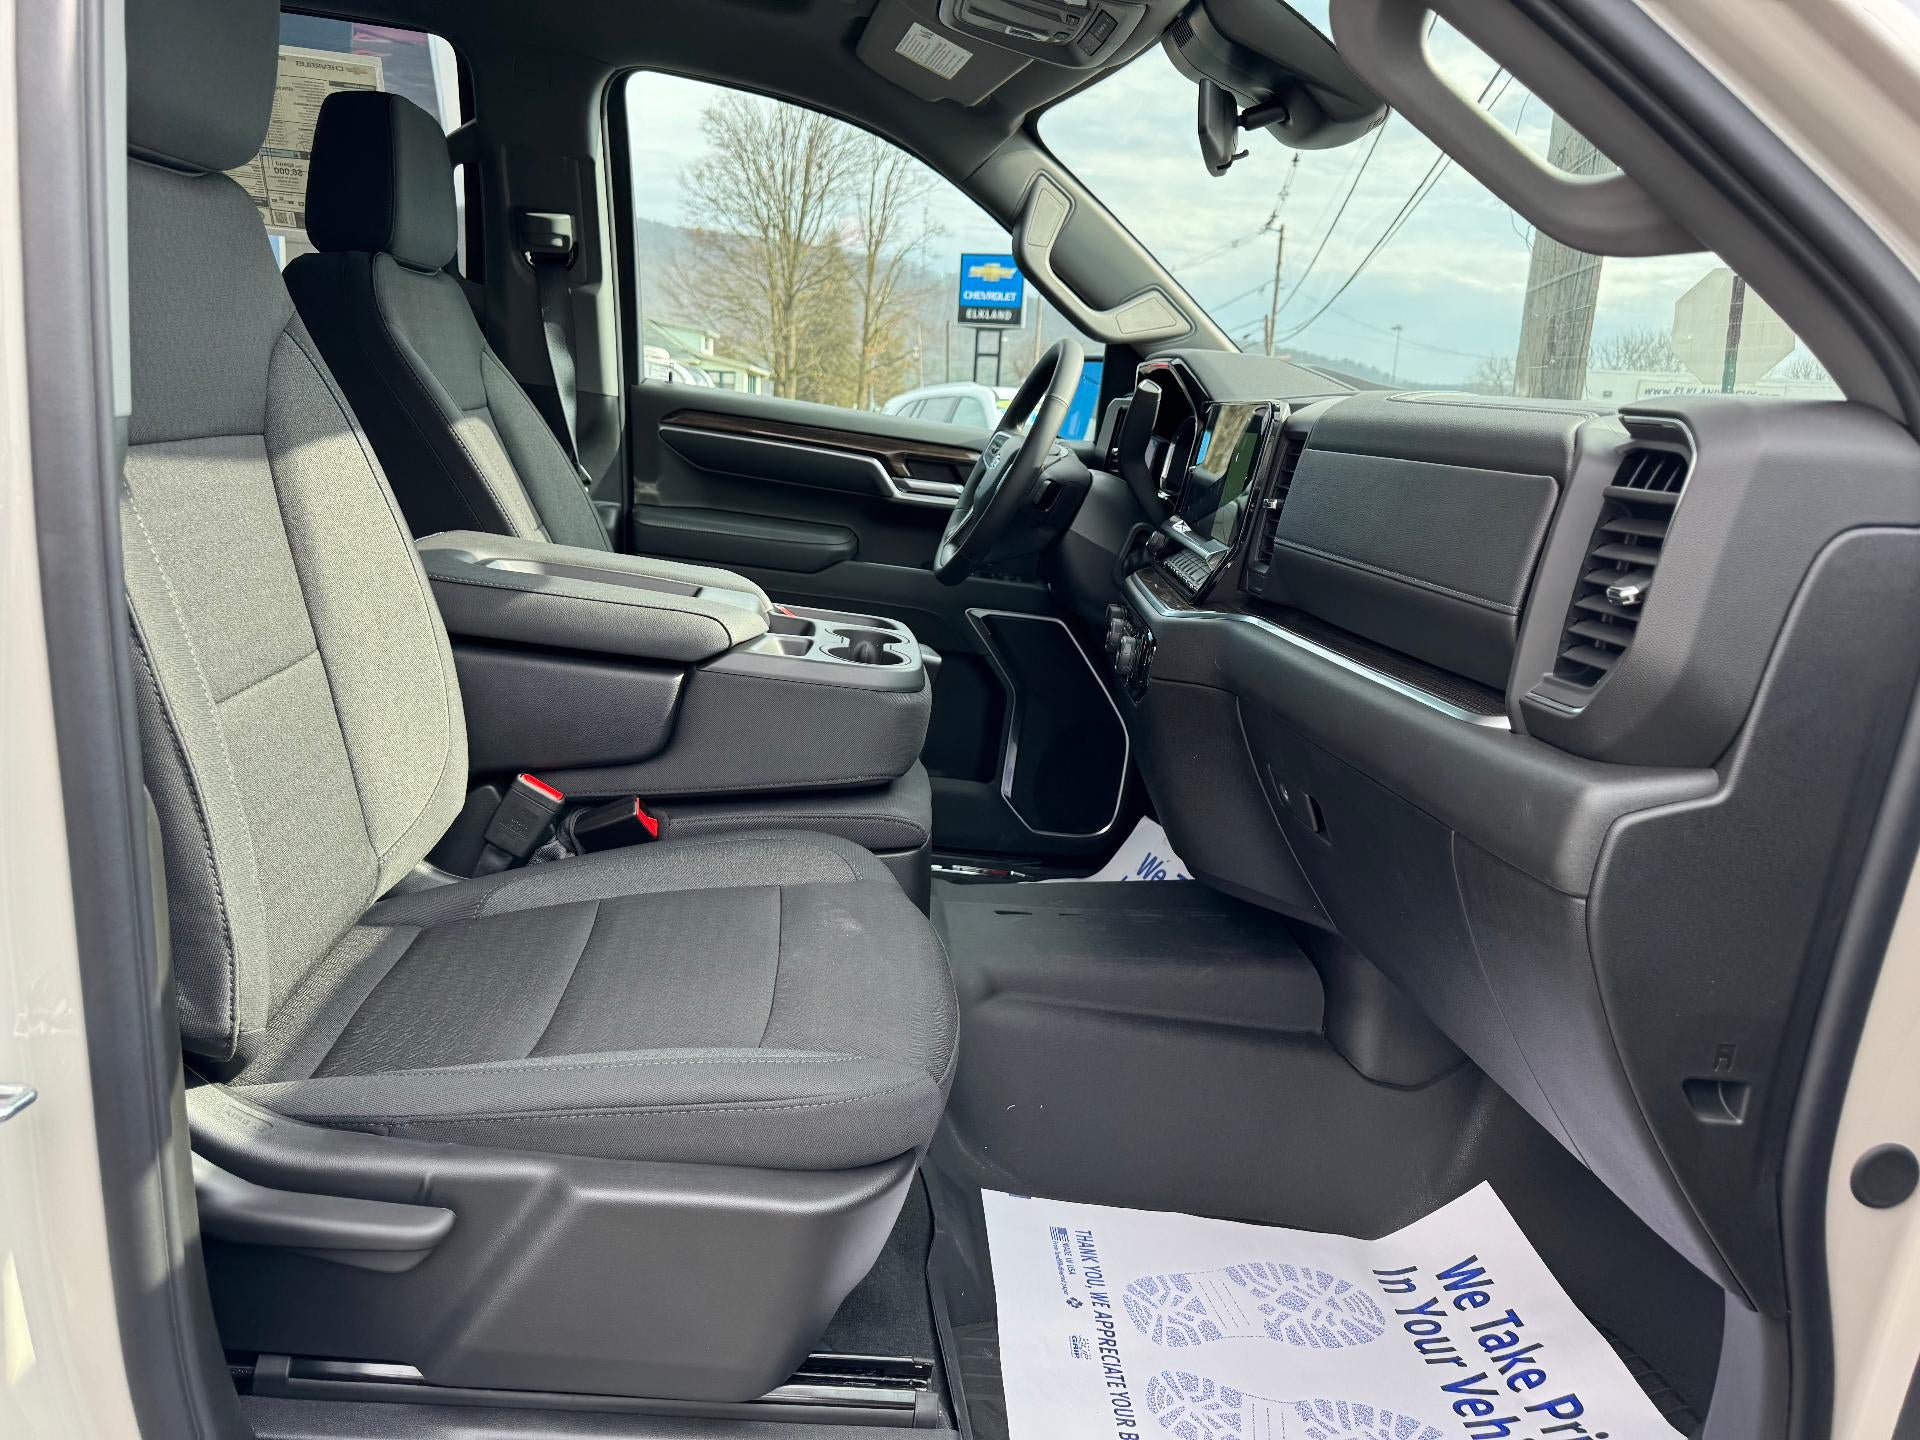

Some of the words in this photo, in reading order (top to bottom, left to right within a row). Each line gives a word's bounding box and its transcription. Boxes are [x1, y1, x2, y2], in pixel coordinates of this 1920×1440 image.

[963, 291, 1016, 301] CHEVROLET
[966, 308, 1012, 320] ELKLAND
[1075, 1230, 1099, 1263] THANK
[1083, 1265, 1106, 1288] YOU,
[1089, 1292, 1111, 1308] WE
[1435, 1254, 1494, 1311] We
[1470, 1308, 1547, 1393] Take
[1094, 1309, 1127, 1388] APPRECIATE
[1372, 1265, 1418, 1294] In
[1395, 1296, 1468, 1368] Your
[1440, 1371, 1535, 1440] Veh
[1109, 1391, 1137, 1427] YOUR
